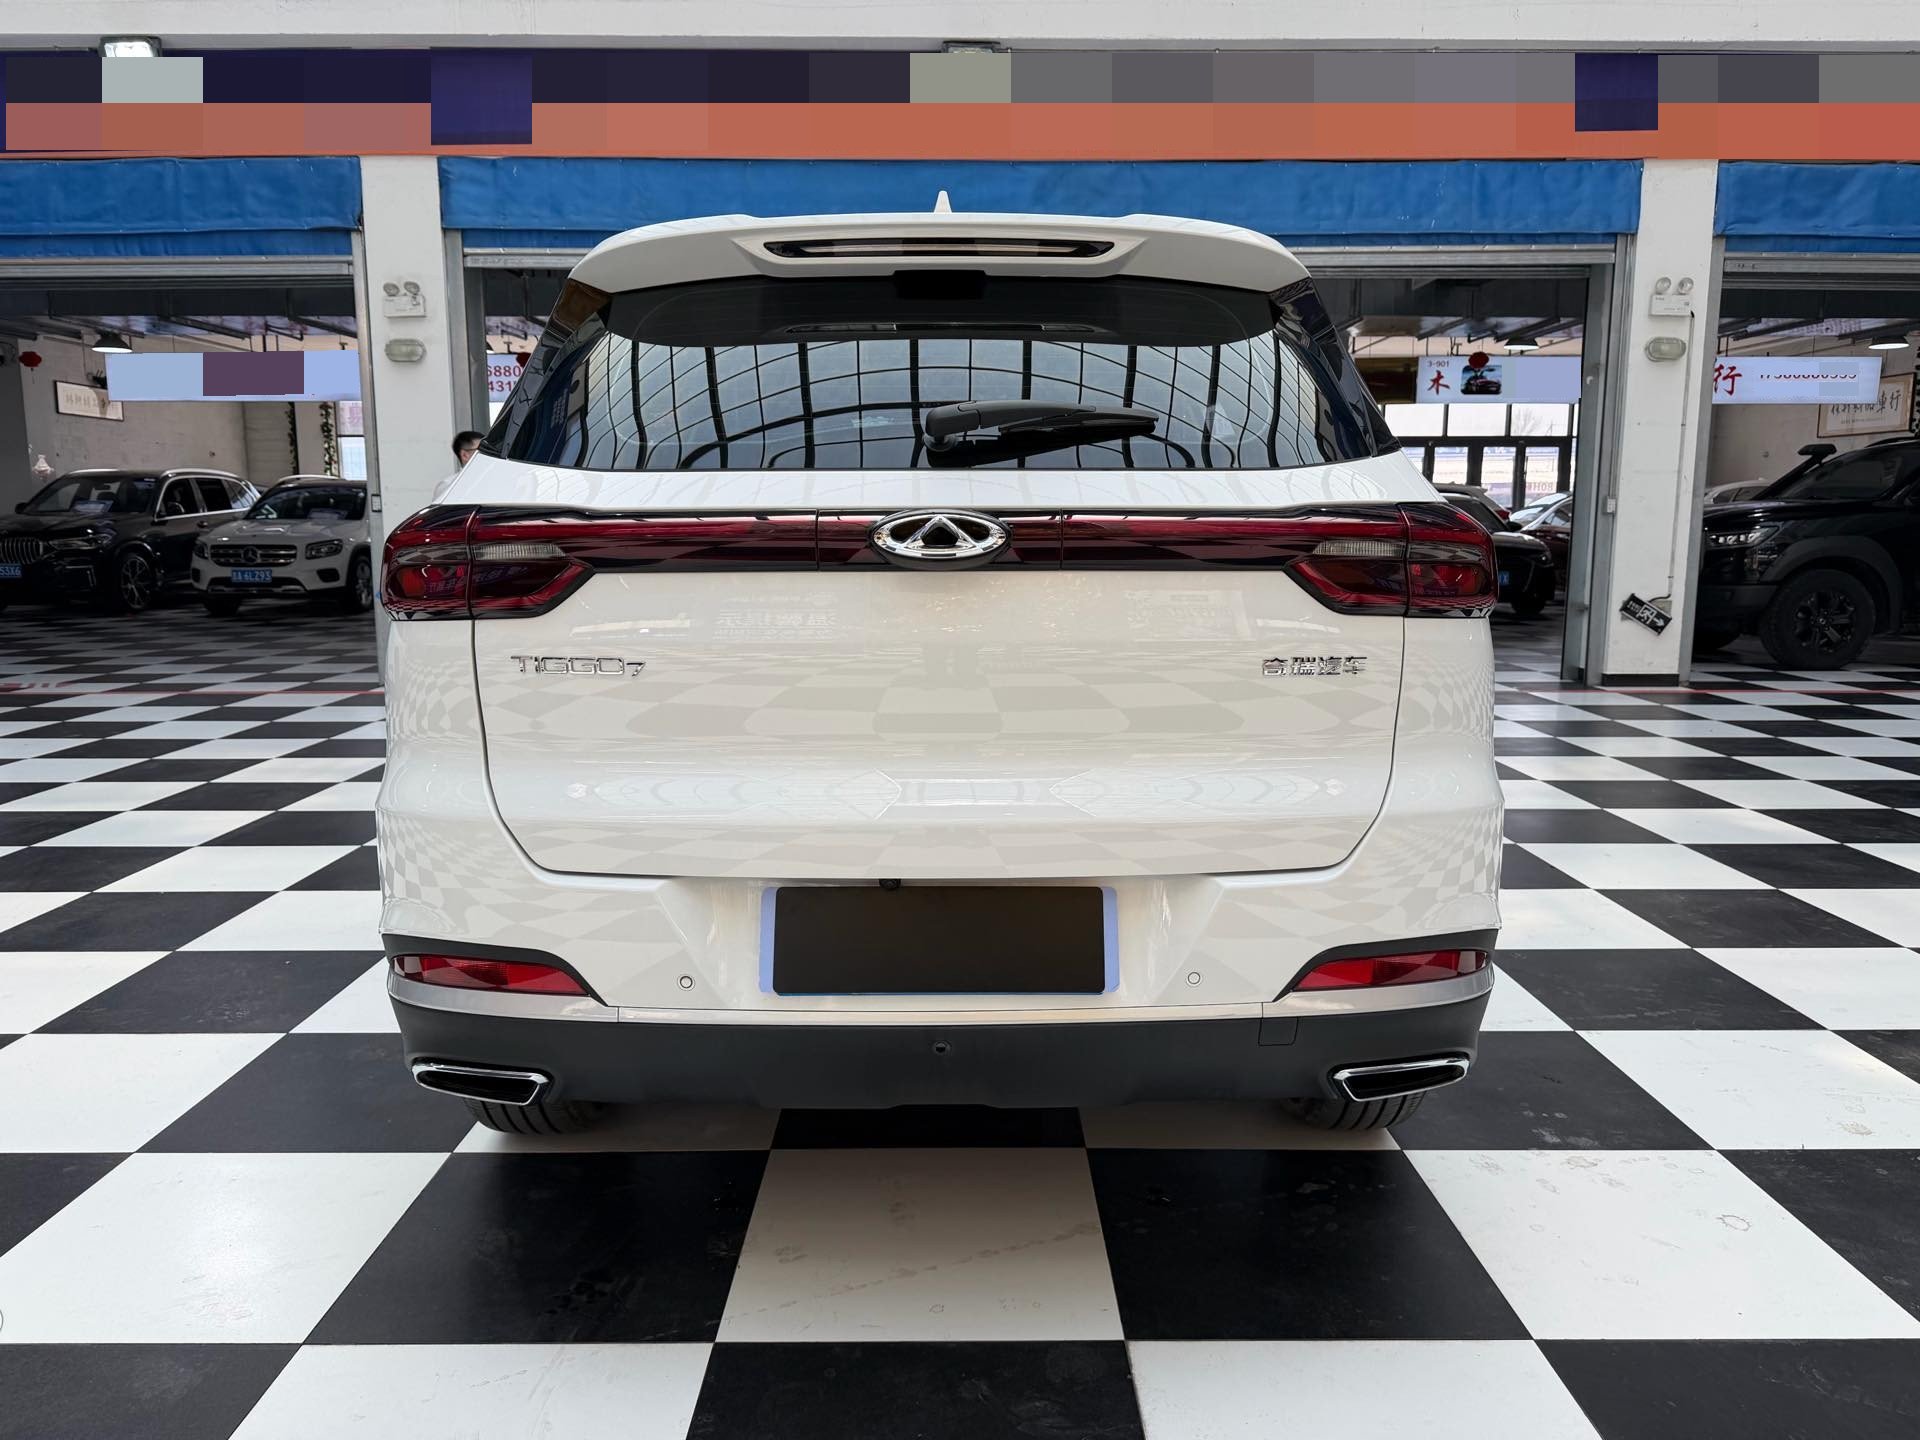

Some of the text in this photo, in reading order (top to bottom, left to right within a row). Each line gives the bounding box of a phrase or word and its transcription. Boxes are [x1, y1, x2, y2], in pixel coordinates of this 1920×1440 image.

[1427, 369, 1450, 395] 木
[1714, 364, 1742, 396] 行
[1263, 656, 1367, 676] 奇瑞汽车
